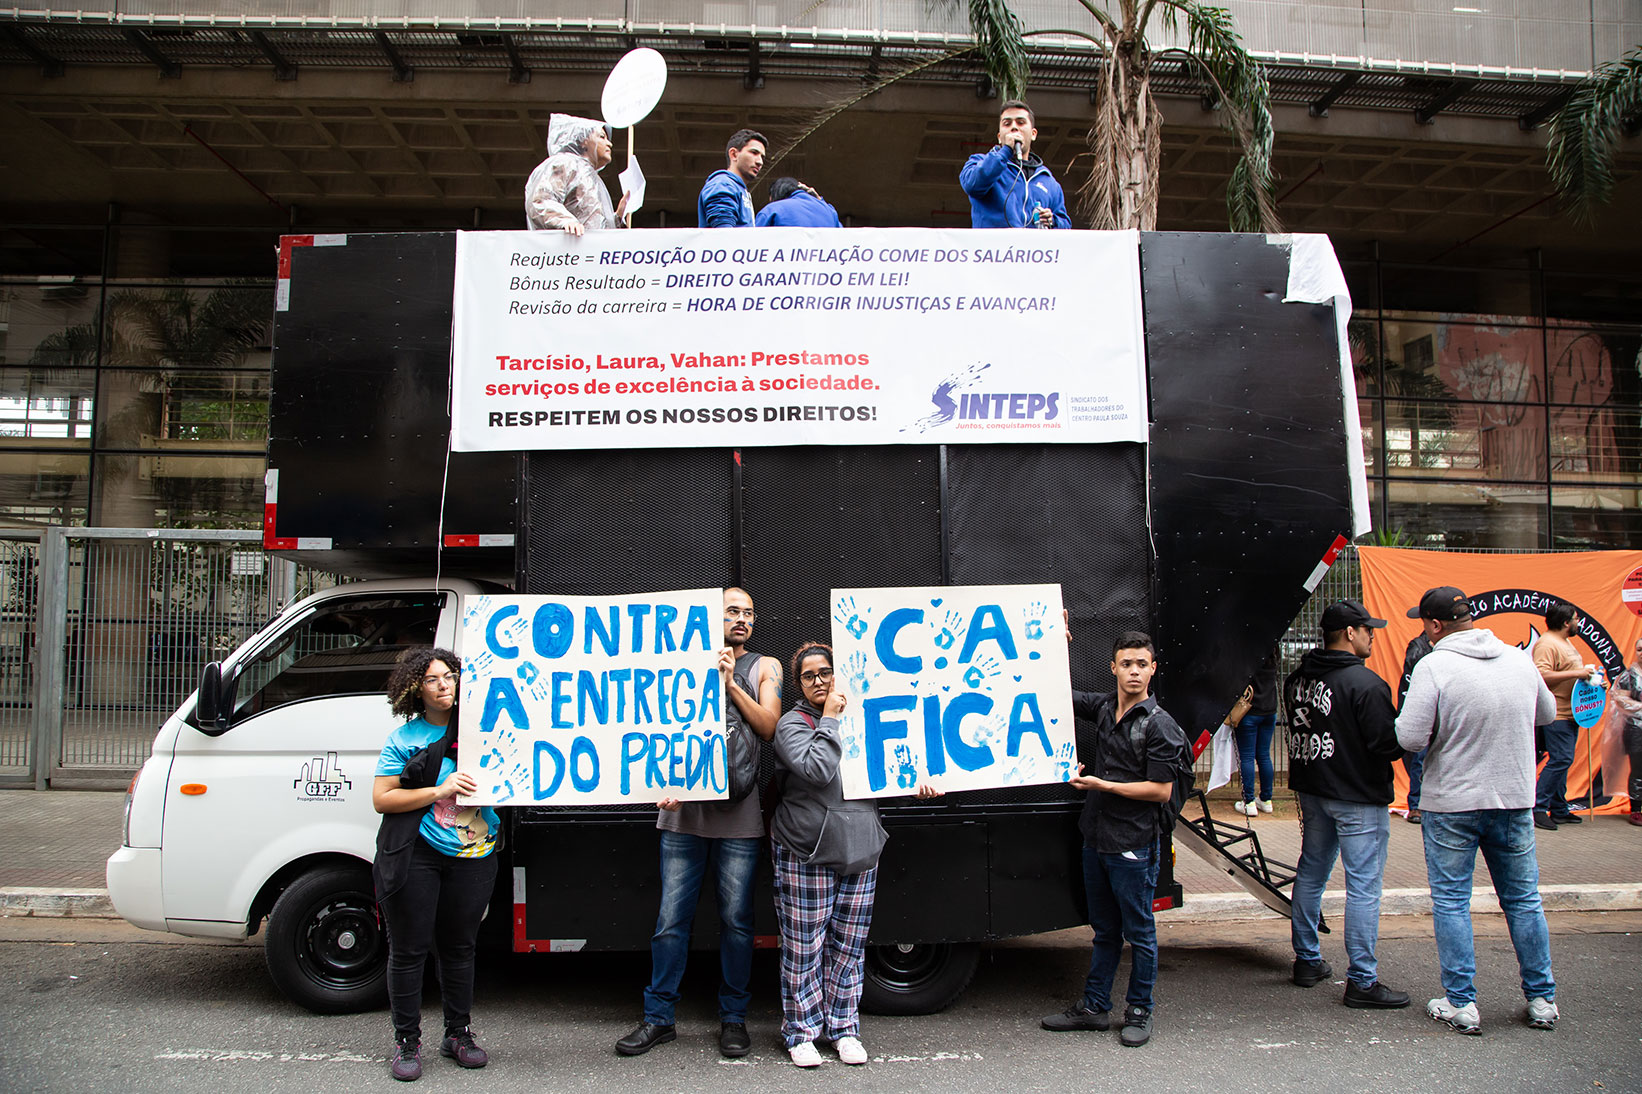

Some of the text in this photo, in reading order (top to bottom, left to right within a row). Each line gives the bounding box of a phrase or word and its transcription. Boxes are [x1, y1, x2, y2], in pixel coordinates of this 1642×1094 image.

[510, 252, 580, 271] Reajuste
[599, 246, 697, 268] REPOSIÇÃO
[701, 249, 728, 264] DO
[732, 248, 769, 265] QUE
[773, 248, 785, 263] A
[790, 244, 874, 266] INFLAÇÃO
[879, 248, 930, 263] COME
[934, 248, 969, 263] DOS
[973, 246, 1060, 264] SALÁRIOS!
[509, 275, 560, 291] Bônus
[565, 274, 646, 291] Resultado
[666, 273, 735, 289] DIREITO
[739, 271, 843, 287] GARANTIDO
[848, 272, 876, 287] EM
[880, 271, 910, 287] LEI!
[509, 299, 572, 315] Revisão
[577, 298, 598, 314] da
[603, 301, 668, 314] carreira
[687, 297, 737, 313] HORA
[742, 296, 766, 311] DE
[770, 295, 852, 311] CORRIGIR
[857, 295, 952, 314] INJUSTIÇAS
[956, 296, 967, 311] E
[970, 296, 1057, 314] AVANÇAR!
[496, 350, 870, 374] Tarcísio, Laura, Vahan: Prestamos
[485, 373, 881, 400] serviços de excelência à sociedade.
[929, 374, 1060, 425] SINTEPS
[489, 405, 877, 427] RESPEITEM OS NOSSOS DIREITOS!
[986, 422, 1041, 430] conquistamos
[1093, 414, 1110, 422] PAULA
[1111, 413, 1128, 421] SOUZA
[1493, 591, 1556, 614] ACADÊM
[486, 603, 711, 660] CONTRA
[479, 667, 720, 732] A ENTREGA
[862, 692, 1054, 793] FICA
[532, 735, 600, 801] DO
[305, 781, 342, 797] GFF
